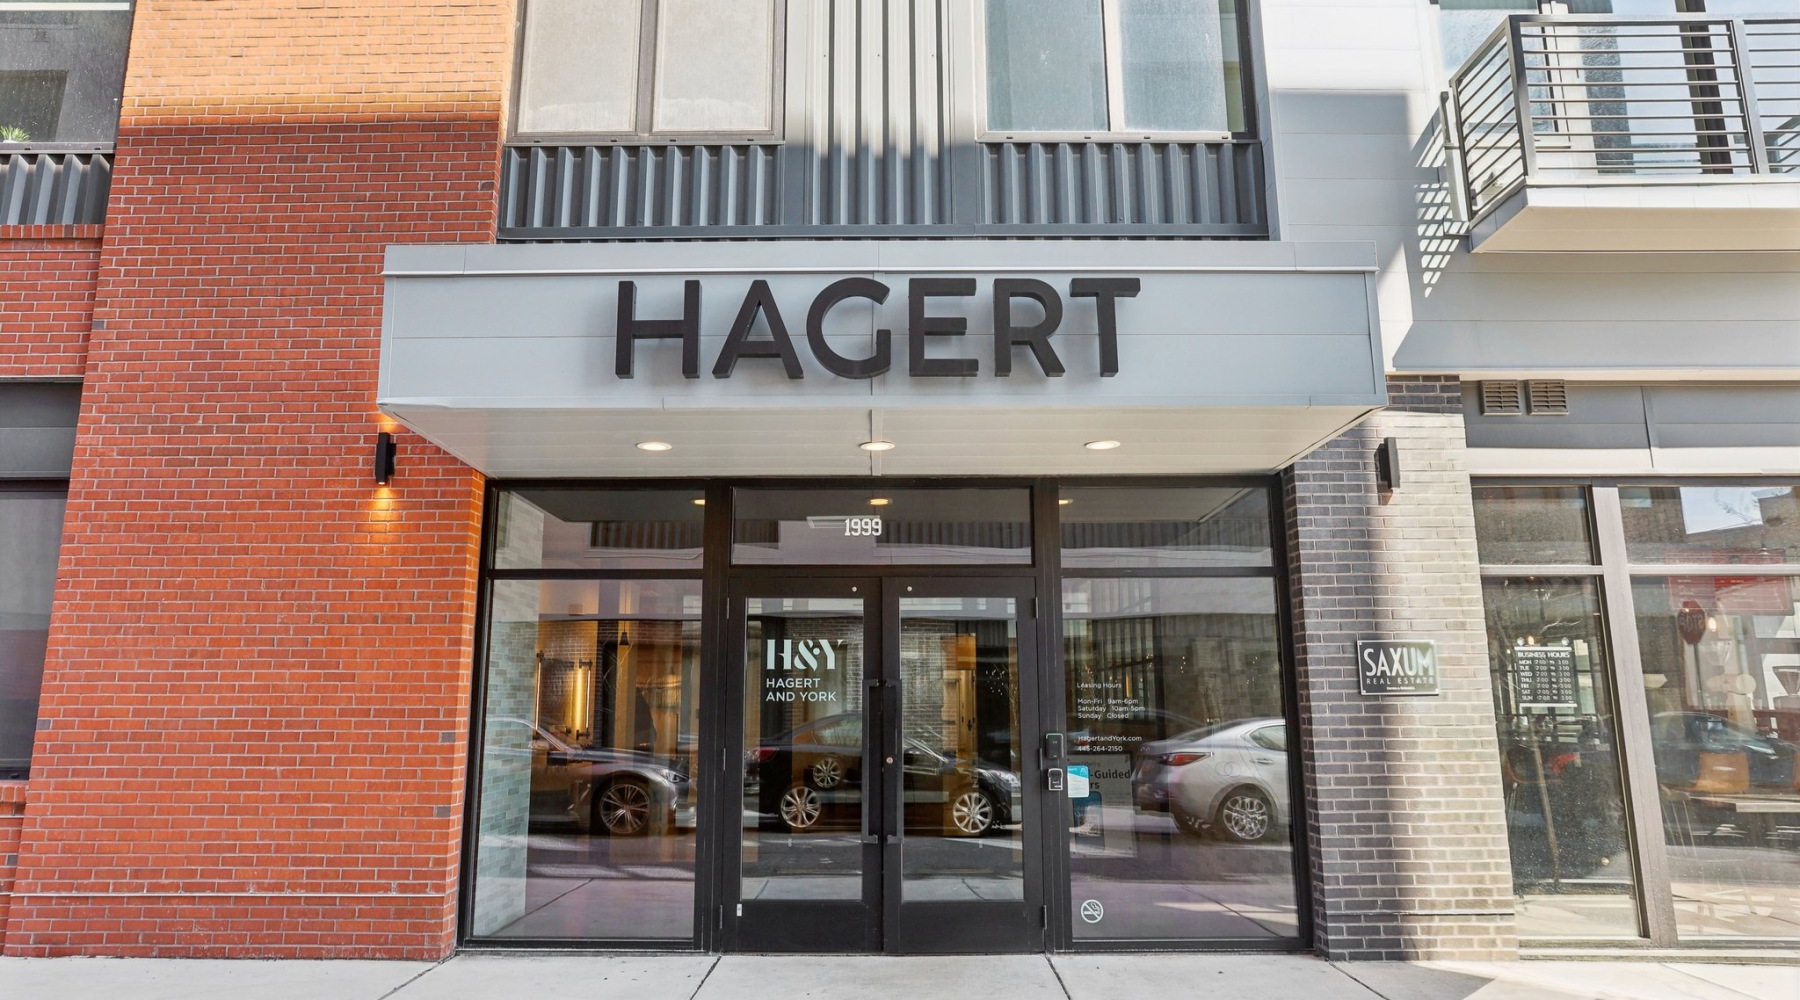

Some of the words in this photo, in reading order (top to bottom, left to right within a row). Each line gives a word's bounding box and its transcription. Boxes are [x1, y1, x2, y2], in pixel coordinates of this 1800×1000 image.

[615, 277, 1141, 379] HAGERT
[844, 518, 882, 536] 1999
[766, 639, 844, 672] H&Y
[1363, 647, 1435, 676] SAXUM
[766, 678, 821, 688] HAGERT
[1397, 677, 1434, 685] ESTATE
[766, 691, 796, 702] AND
[800, 691, 837, 702] YORK
[1077, 705, 1107, 713] Saturday
[1077, 712, 1102, 720] Sunday
[1090, 769, 1130, 779] -Guided
